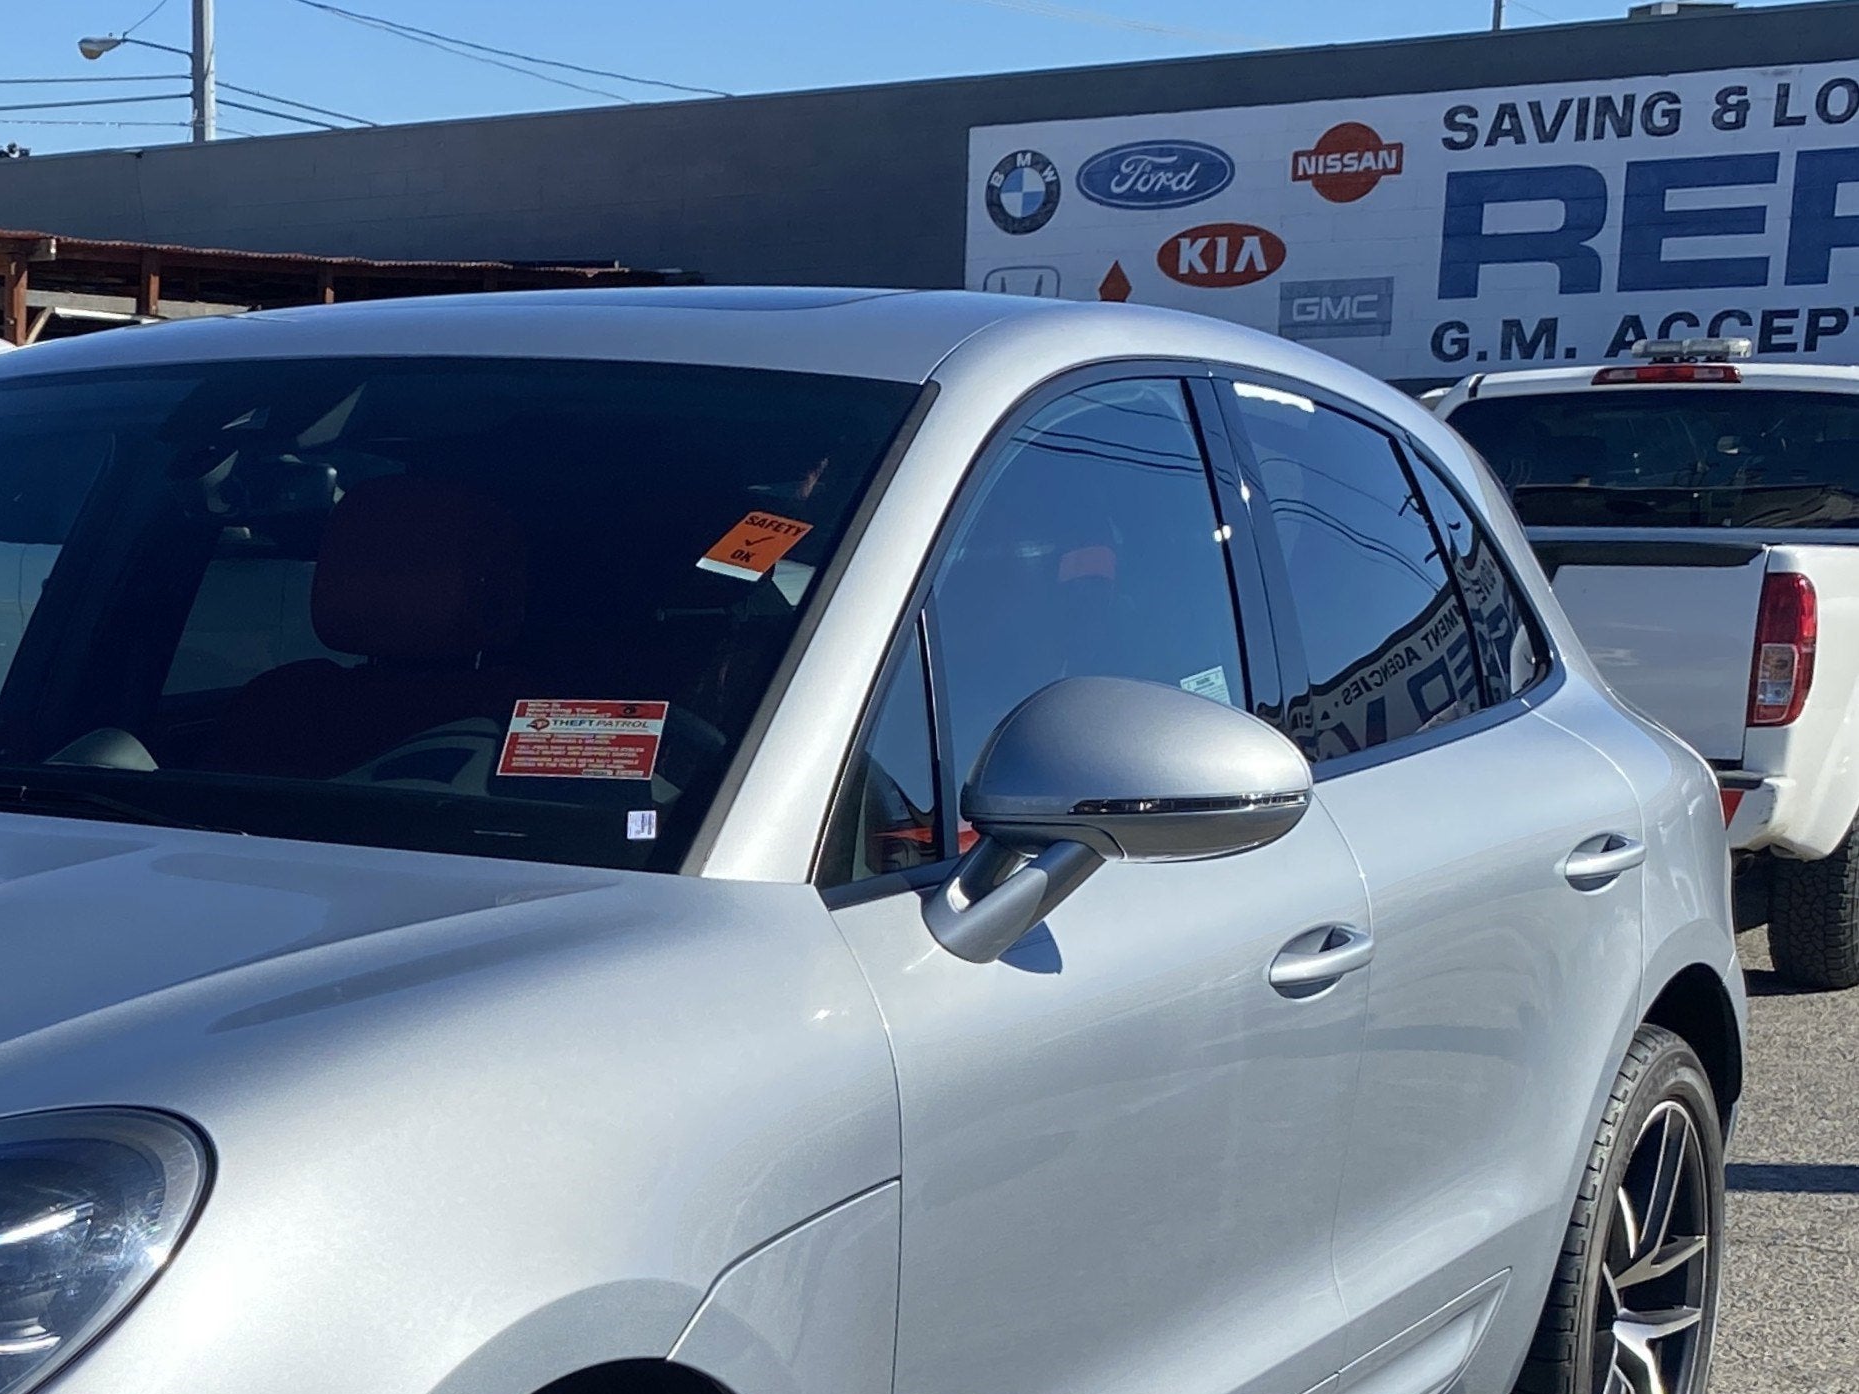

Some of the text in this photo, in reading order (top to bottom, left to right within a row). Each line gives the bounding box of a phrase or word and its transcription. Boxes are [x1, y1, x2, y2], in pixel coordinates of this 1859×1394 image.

[1441, 91, 1682, 151] SAVING
[1711, 86, 1751, 130] &
[991, 152, 1058, 189] BMW
[1111, 154, 1197, 194] Ford
[1297, 150, 1398, 176] NISSAN
[1177, 235, 1269, 275] KIA
[1292, 295, 1379, 322] GMC
[1430, 307, 1859, 363] G.M. ACCEP
[744, 515, 805, 537] SAFETY
[730, 549, 756, 563] OK
[552, 719, 650, 728] THEFT PATROL
